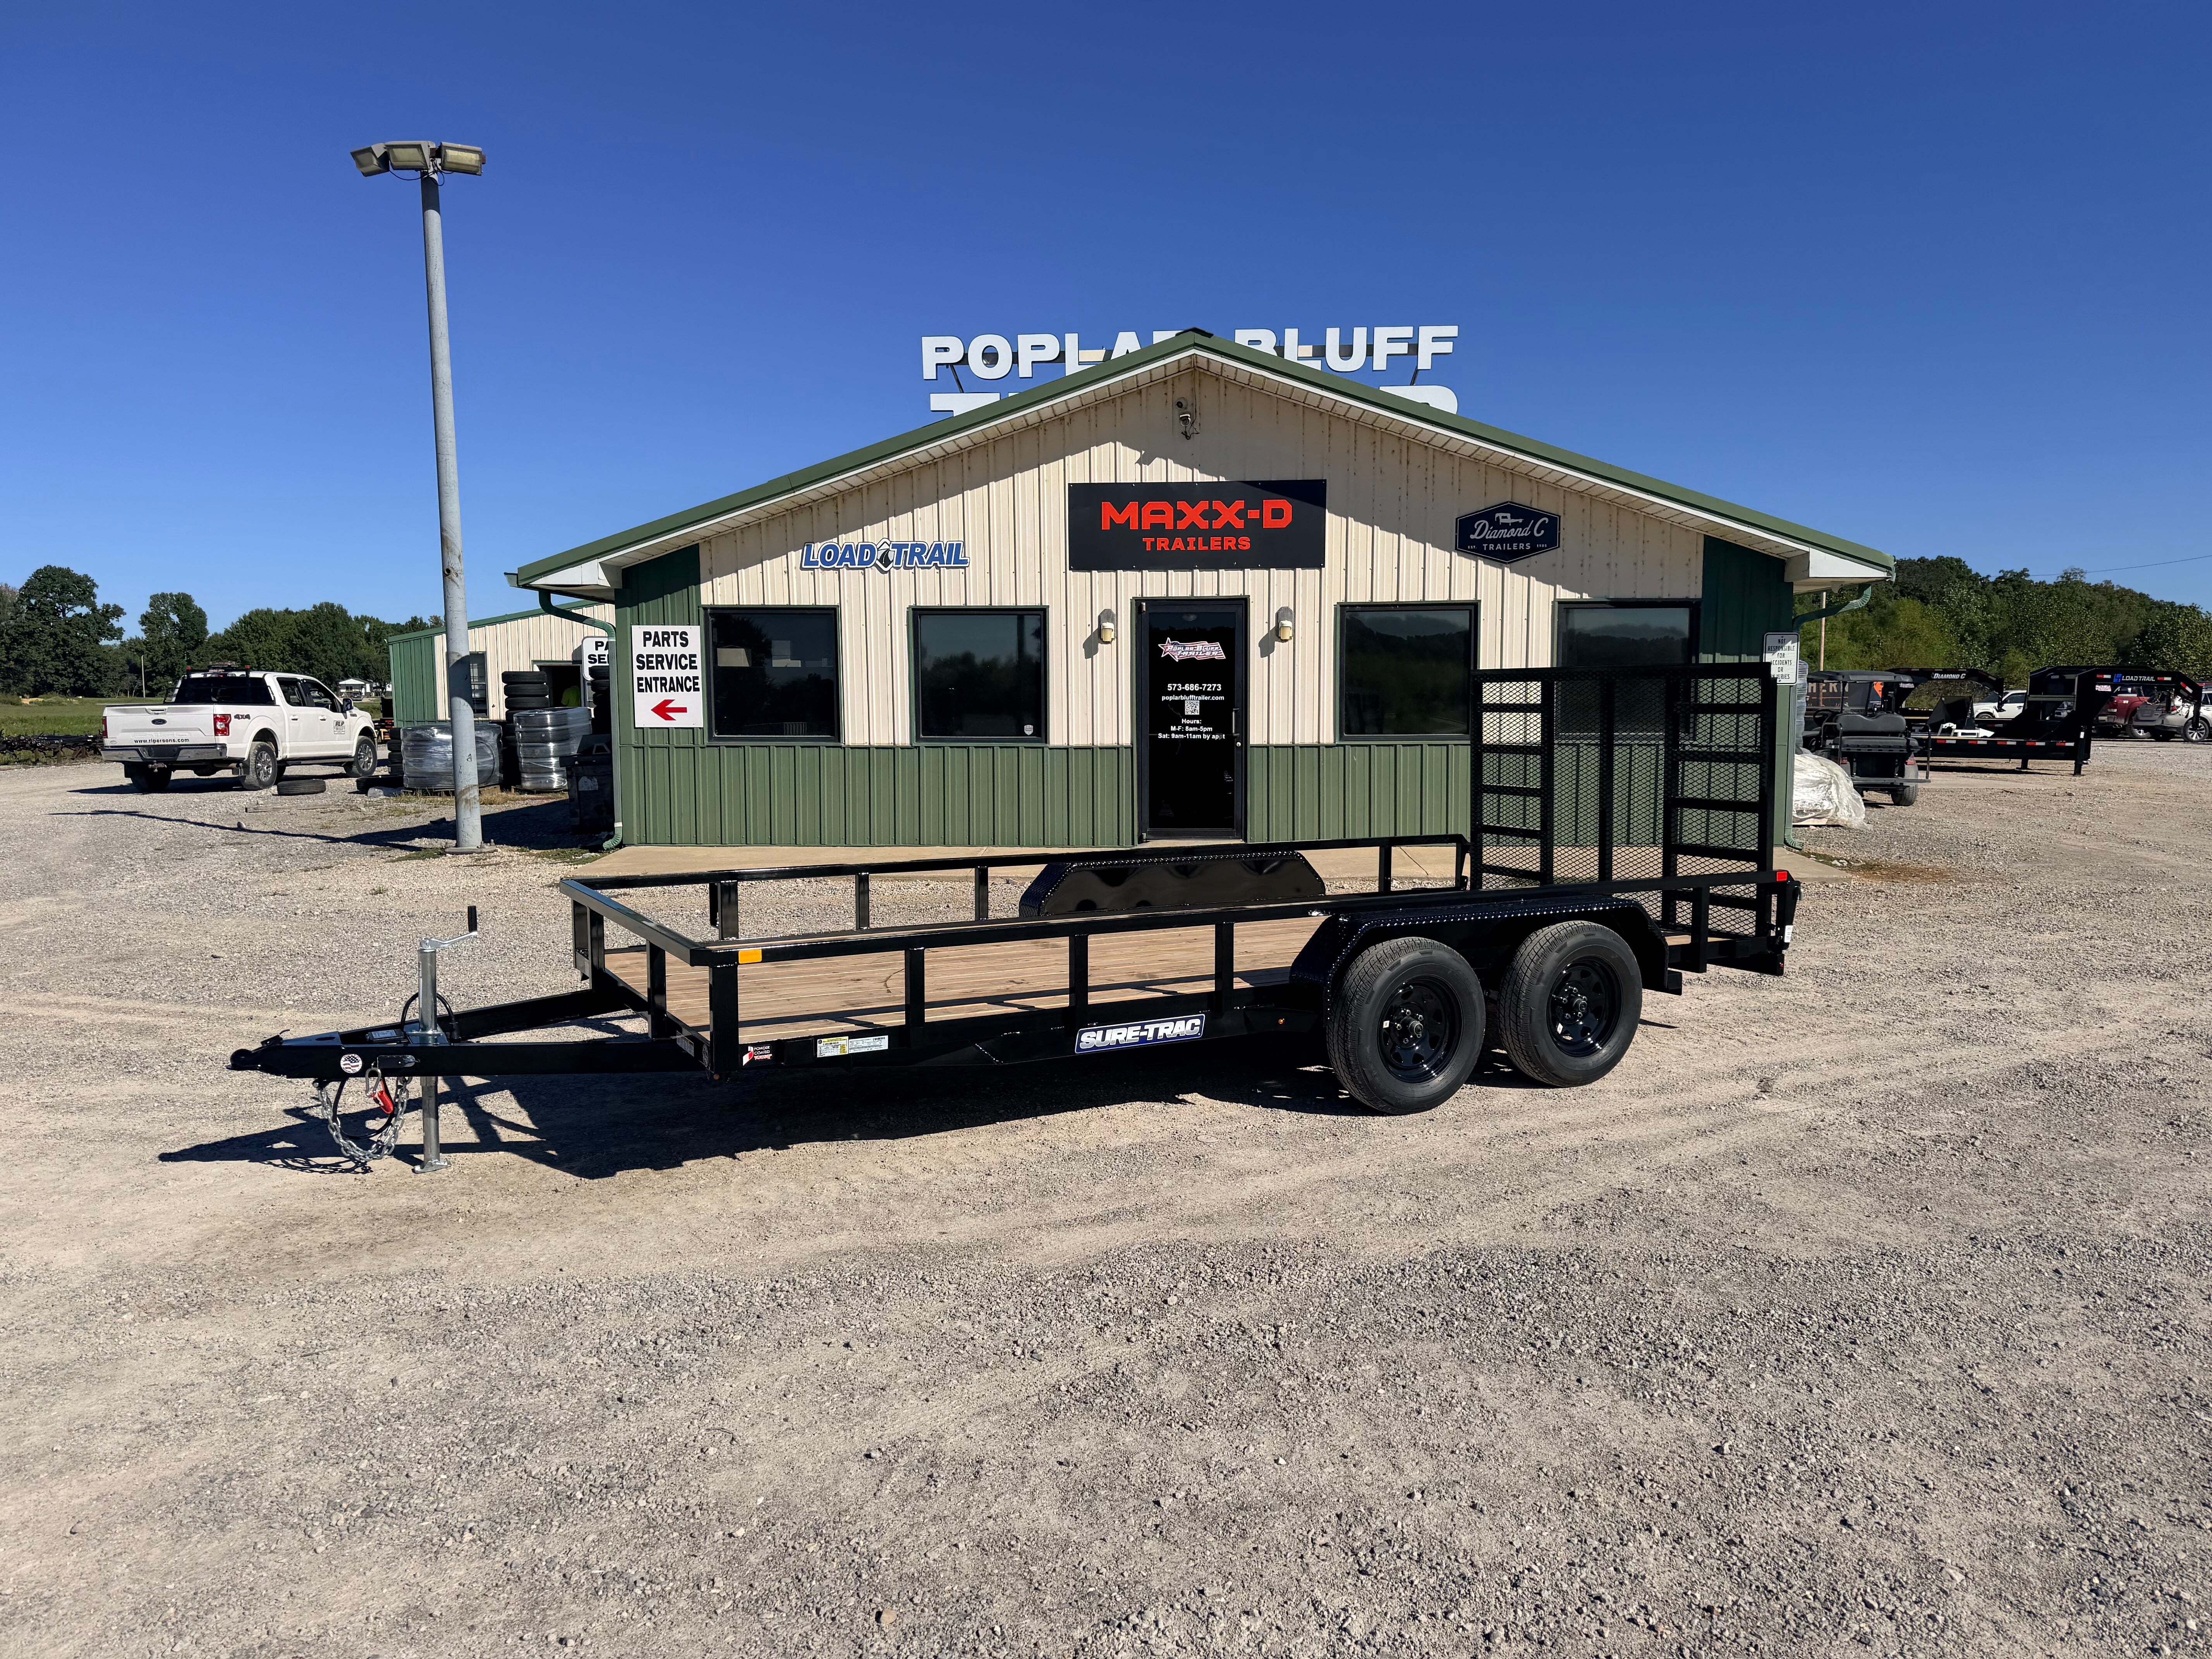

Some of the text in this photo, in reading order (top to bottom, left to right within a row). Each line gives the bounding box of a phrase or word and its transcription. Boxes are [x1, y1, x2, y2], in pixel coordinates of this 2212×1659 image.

[922, 325, 1458, 380] POPLA BLUFF
[1102, 499, 1292, 530] MAXX-D
[1470, 517, 1549, 539] Diamond C
[1142, 536, 1251, 551] TRAILERS
[802, 542, 970, 568] LOAD TRAIL
[643, 631, 689, 647] PARTS
[636, 654, 697, 670] SERVICE
[637, 676, 700, 692] ENTRANCE
[1080, 1018, 1201, 1049] SURE-TRAC
